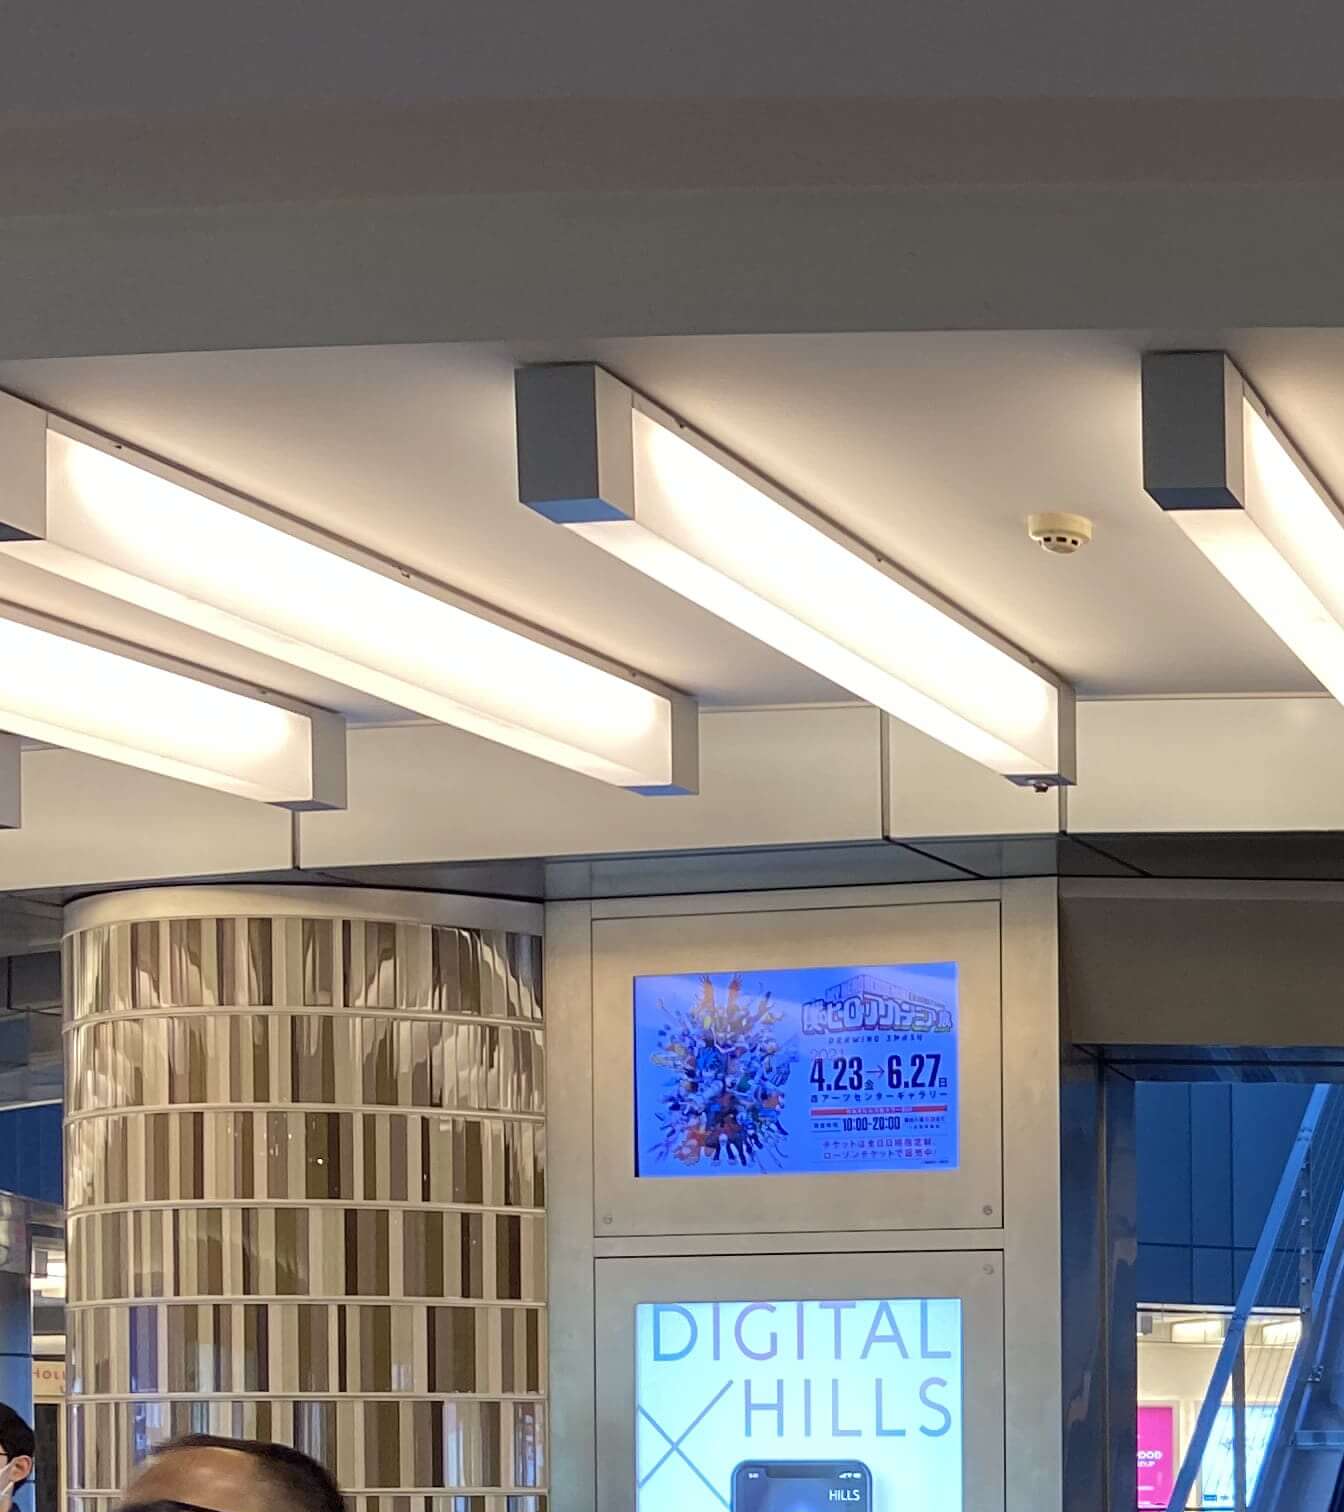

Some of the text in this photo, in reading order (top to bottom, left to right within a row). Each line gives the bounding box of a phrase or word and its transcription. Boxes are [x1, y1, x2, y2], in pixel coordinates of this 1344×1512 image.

[809, 1055, 863, 1091] 4.23
[887, 1053, 942, 1089] 6.27
[843, 1116, 901, 1132] 10:00-20:00
[652, 1300, 952, 1362] DIGITAL
[744, 1377, 952, 1438] HILLS
[829, 1489, 860, 1501] HILLS
